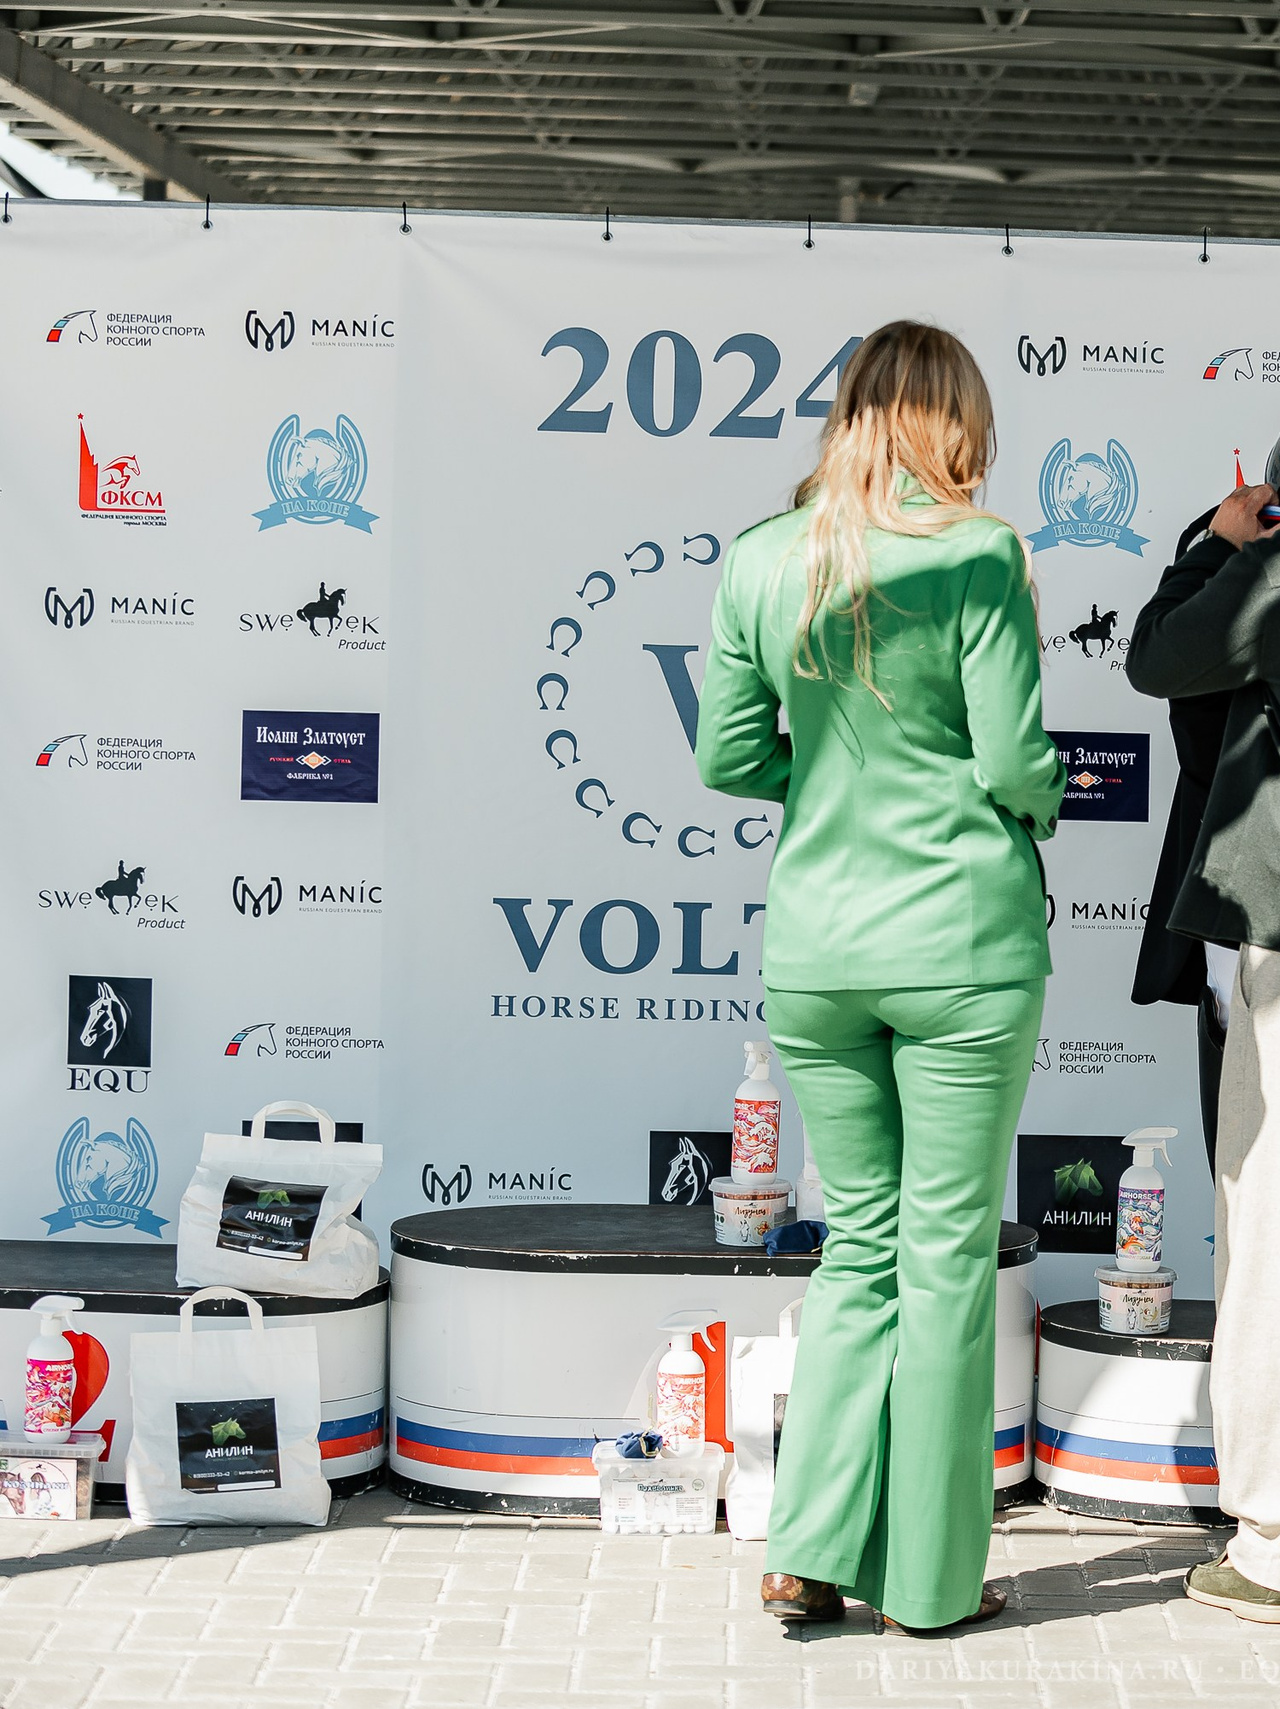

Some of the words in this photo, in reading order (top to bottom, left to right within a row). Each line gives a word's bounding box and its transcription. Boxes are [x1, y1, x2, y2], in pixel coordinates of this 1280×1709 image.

[106, 313, 172, 325] ФЕДЕРАЦИЯ
[106, 325, 160, 336] КОННОГО
[163, 326, 206, 337] СПОРТА
[311, 314, 396, 338] MANÍC
[106, 336, 152, 347] РОССИИ
[1082, 340, 1165, 366] MANÍC
[101, 491, 163, 507] ФКСМ
[282, 501, 304, 516] НА
[307, 500, 350, 518] КОНЕ
[1054, 524, 1076, 538] НА
[1078, 523, 1121, 540] КОНЕ
[111, 592, 195, 616] MANÍC
[338, 638, 386, 651] Product
[97, 737, 162, 748] ФЕДЕРАЦИЯ
[97, 749, 151, 760] КОННОГО
[154, 750, 196, 761] СПОРТА
[97, 760, 143, 772] РОССИИ
[286, 772, 321, 780] ФАБРИКА
[299, 880, 383, 904] MANÍC
[1072, 897, 1151, 921] MANÍC
[137, 916, 185, 929] Product
[491, 995, 620, 1020] HORSE
[285, 1026, 351, 1037] ФЕДЕРАЦИЯ
[285, 1038, 339, 1049] КОННОГО
[342, 1039, 385, 1049] СПОРТА
[1059, 1041, 1124, 1052] ФЕДЕРАЦИЯ
[285, 1049, 331, 1060] РОССИИ
[1059, 1053, 1112, 1064] КОННОГО
[1114, 1053, 1157, 1065] СПОРТА
[1059, 1064, 1105, 1075] РОССИИ
[66, 1066, 152, 1094] EQU
[488, 1167, 573, 1192] MANÍC
[71, 1204, 93, 1220] НА
[96, 1203, 140, 1222] КОНЕ
[245, 1210, 292, 1227] АНИЛИН
[1043, 1210, 1112, 1226] АНИЛИН
[205, 1445, 253, 1459] АНИЛИН
